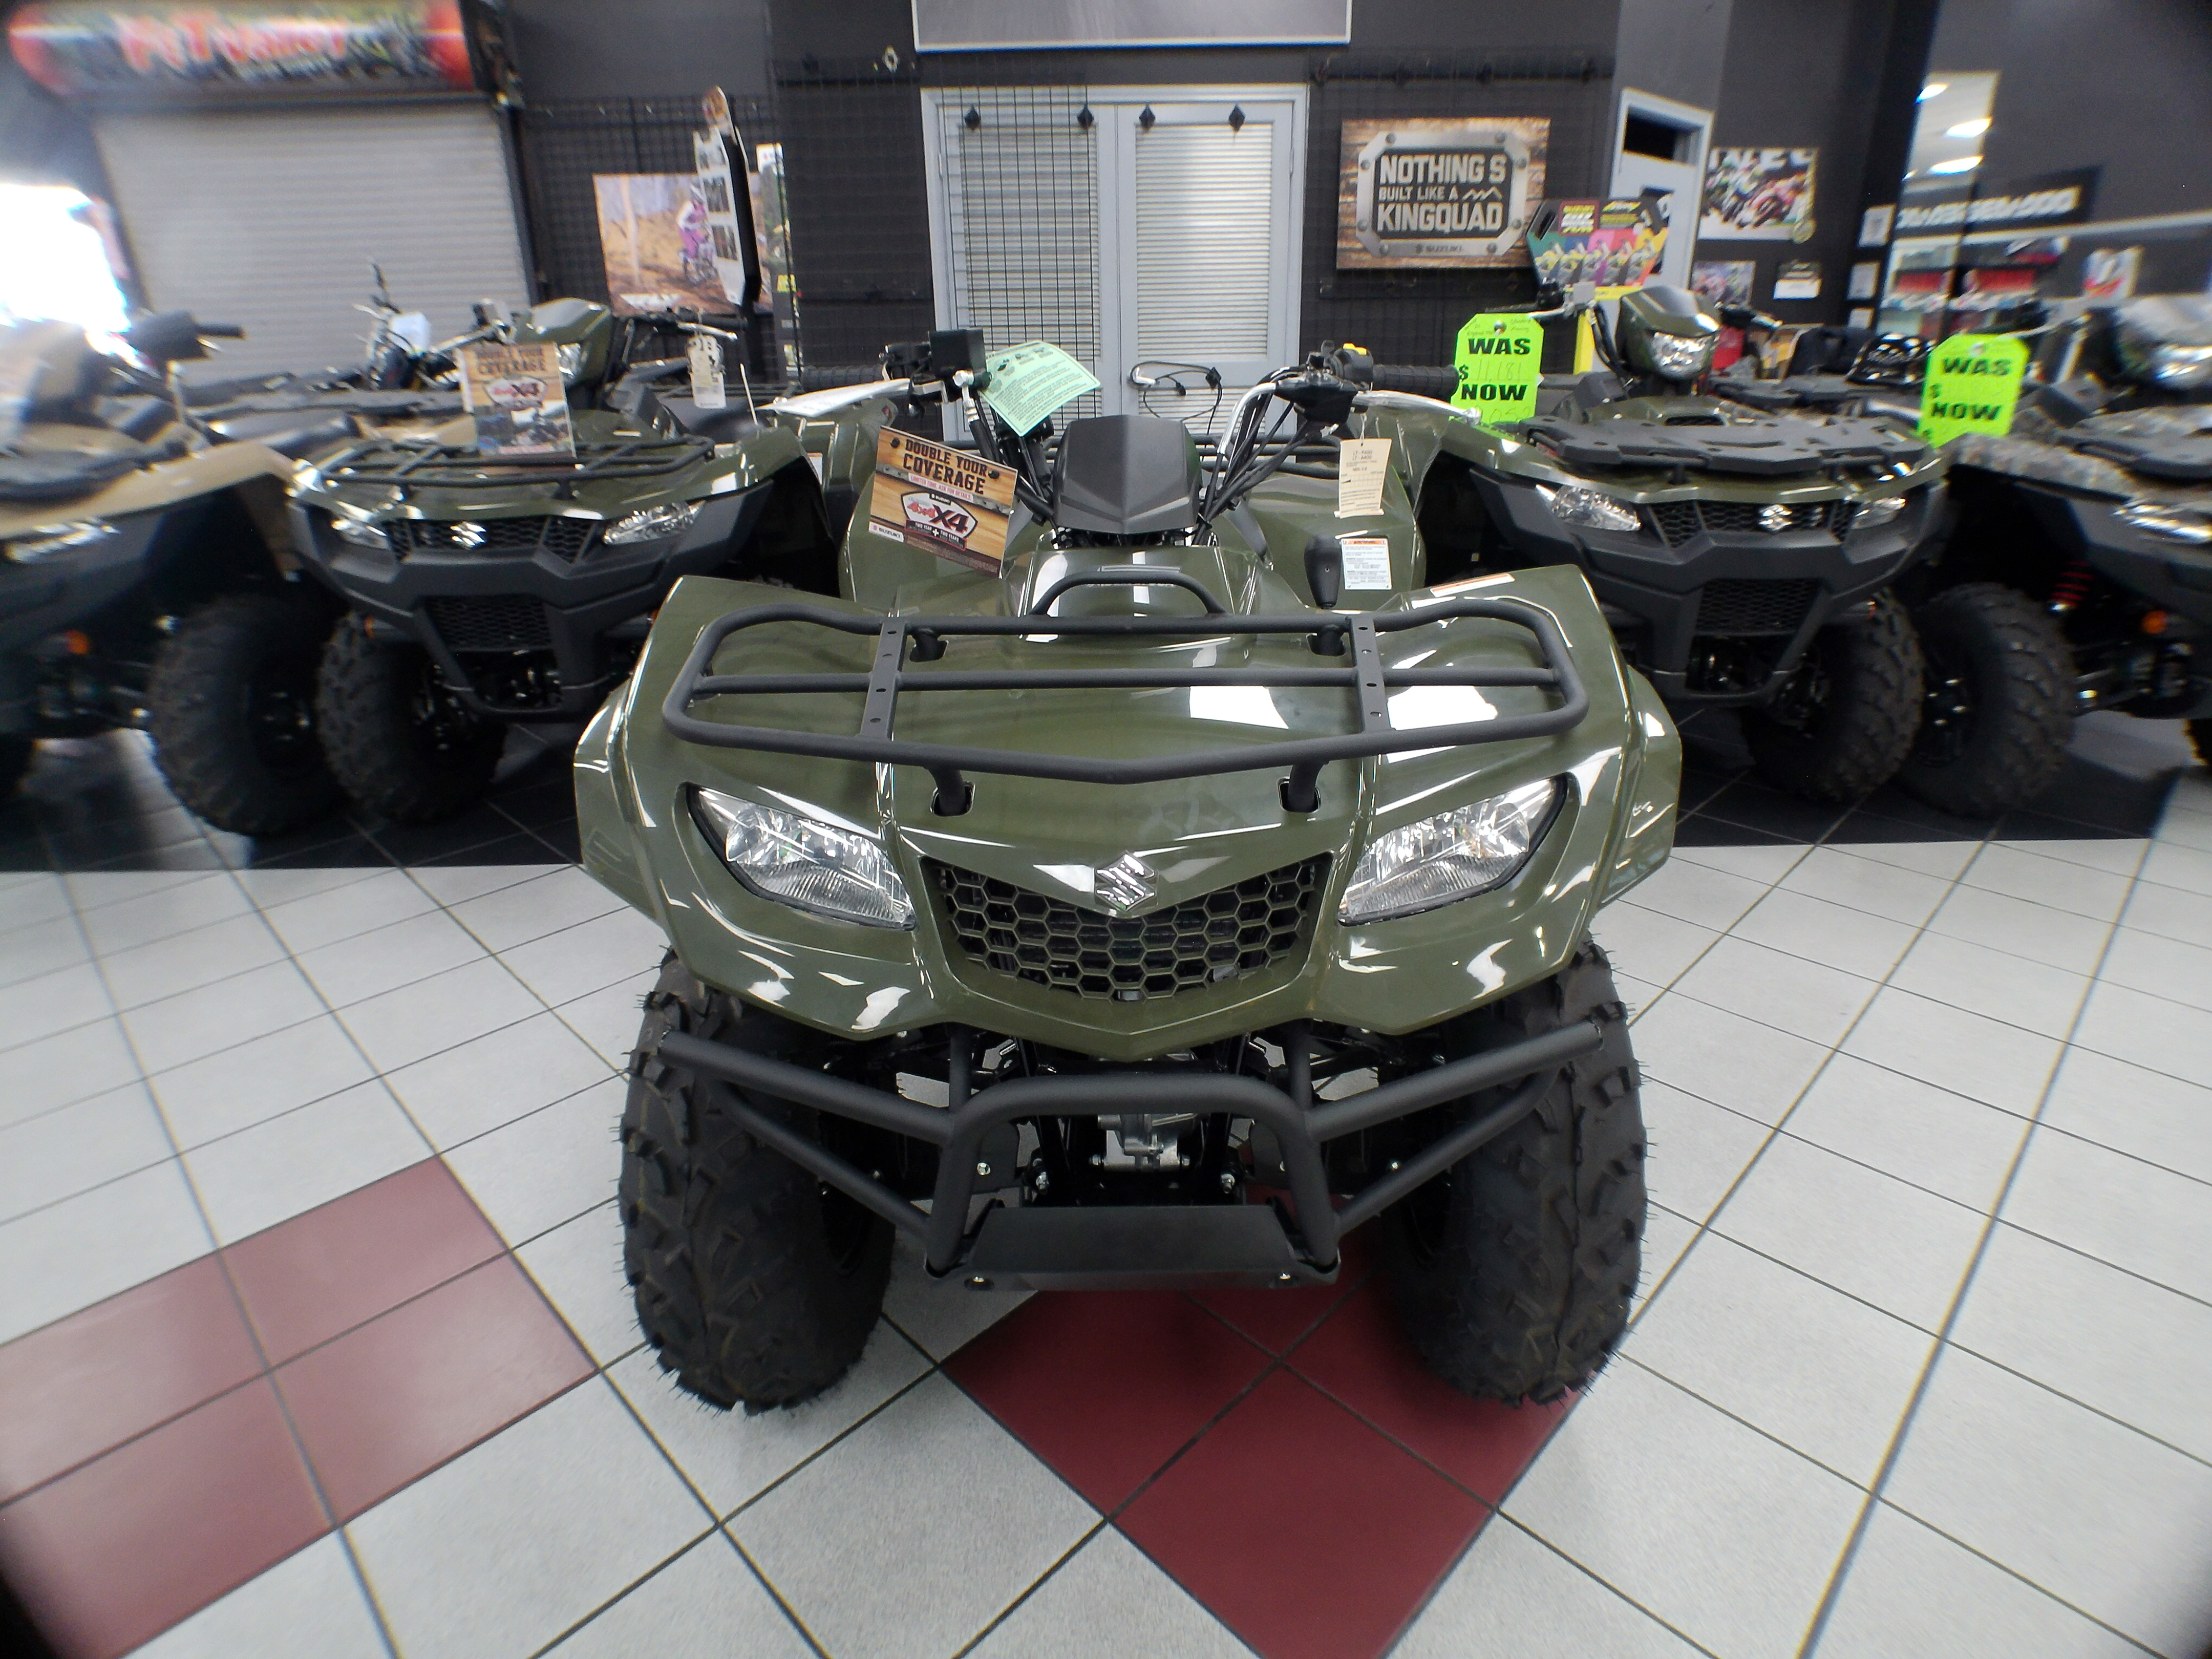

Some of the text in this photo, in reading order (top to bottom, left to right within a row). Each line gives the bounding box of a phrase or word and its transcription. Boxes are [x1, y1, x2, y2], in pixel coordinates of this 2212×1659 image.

[1378, 185, 1459, 201] BUILT LIKE A
[1377, 202, 1503, 235] KINGQUAD
[1468, 337, 1532, 355] WAS
[1459, 364, 1469, 381] $
[1942, 357, 2011, 376] WAS
[1461, 384, 1528, 401] NOW
[1931, 402, 2002, 420] NOW
[905, 438, 987, 477] DOUBLE YOUR
[903, 453, 985, 495] COVERAGE
[879, 527, 901, 538] SUZUKI
